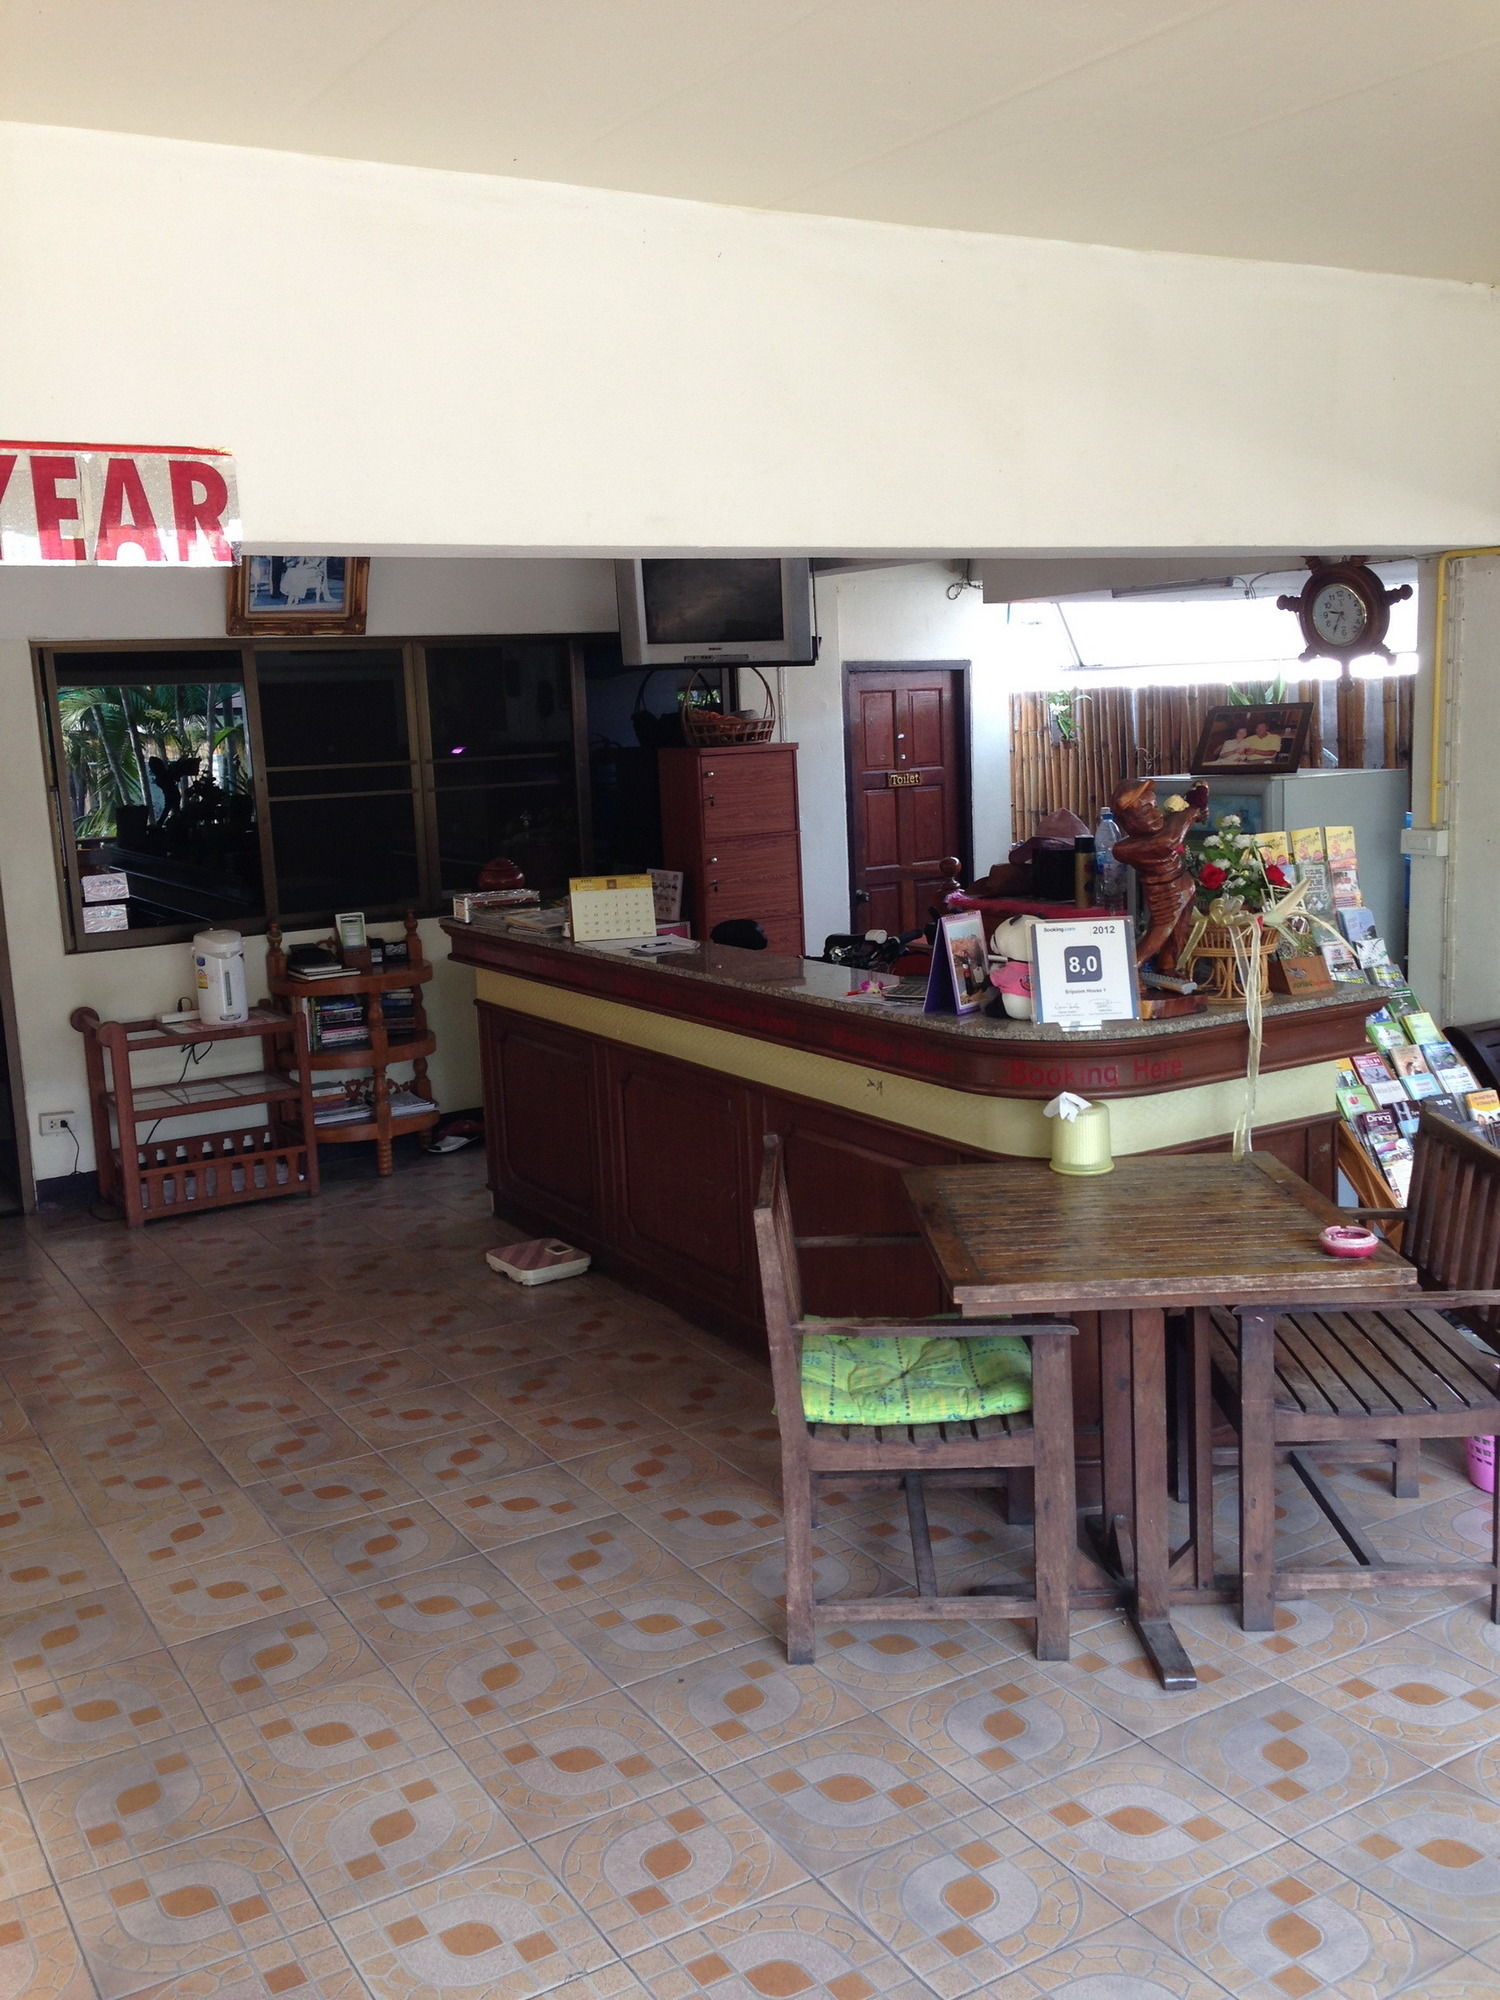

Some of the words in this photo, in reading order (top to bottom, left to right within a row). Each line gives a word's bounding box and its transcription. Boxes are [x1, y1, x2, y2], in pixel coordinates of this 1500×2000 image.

[891, 773, 919, 785] Toilet
[1092, 925, 1116, 935] 2012
[1068, 955, 1098, 975] 8,0
[1009, 1060, 1118, 1088] Booking
[1132, 1058, 1185, 1082] Here
